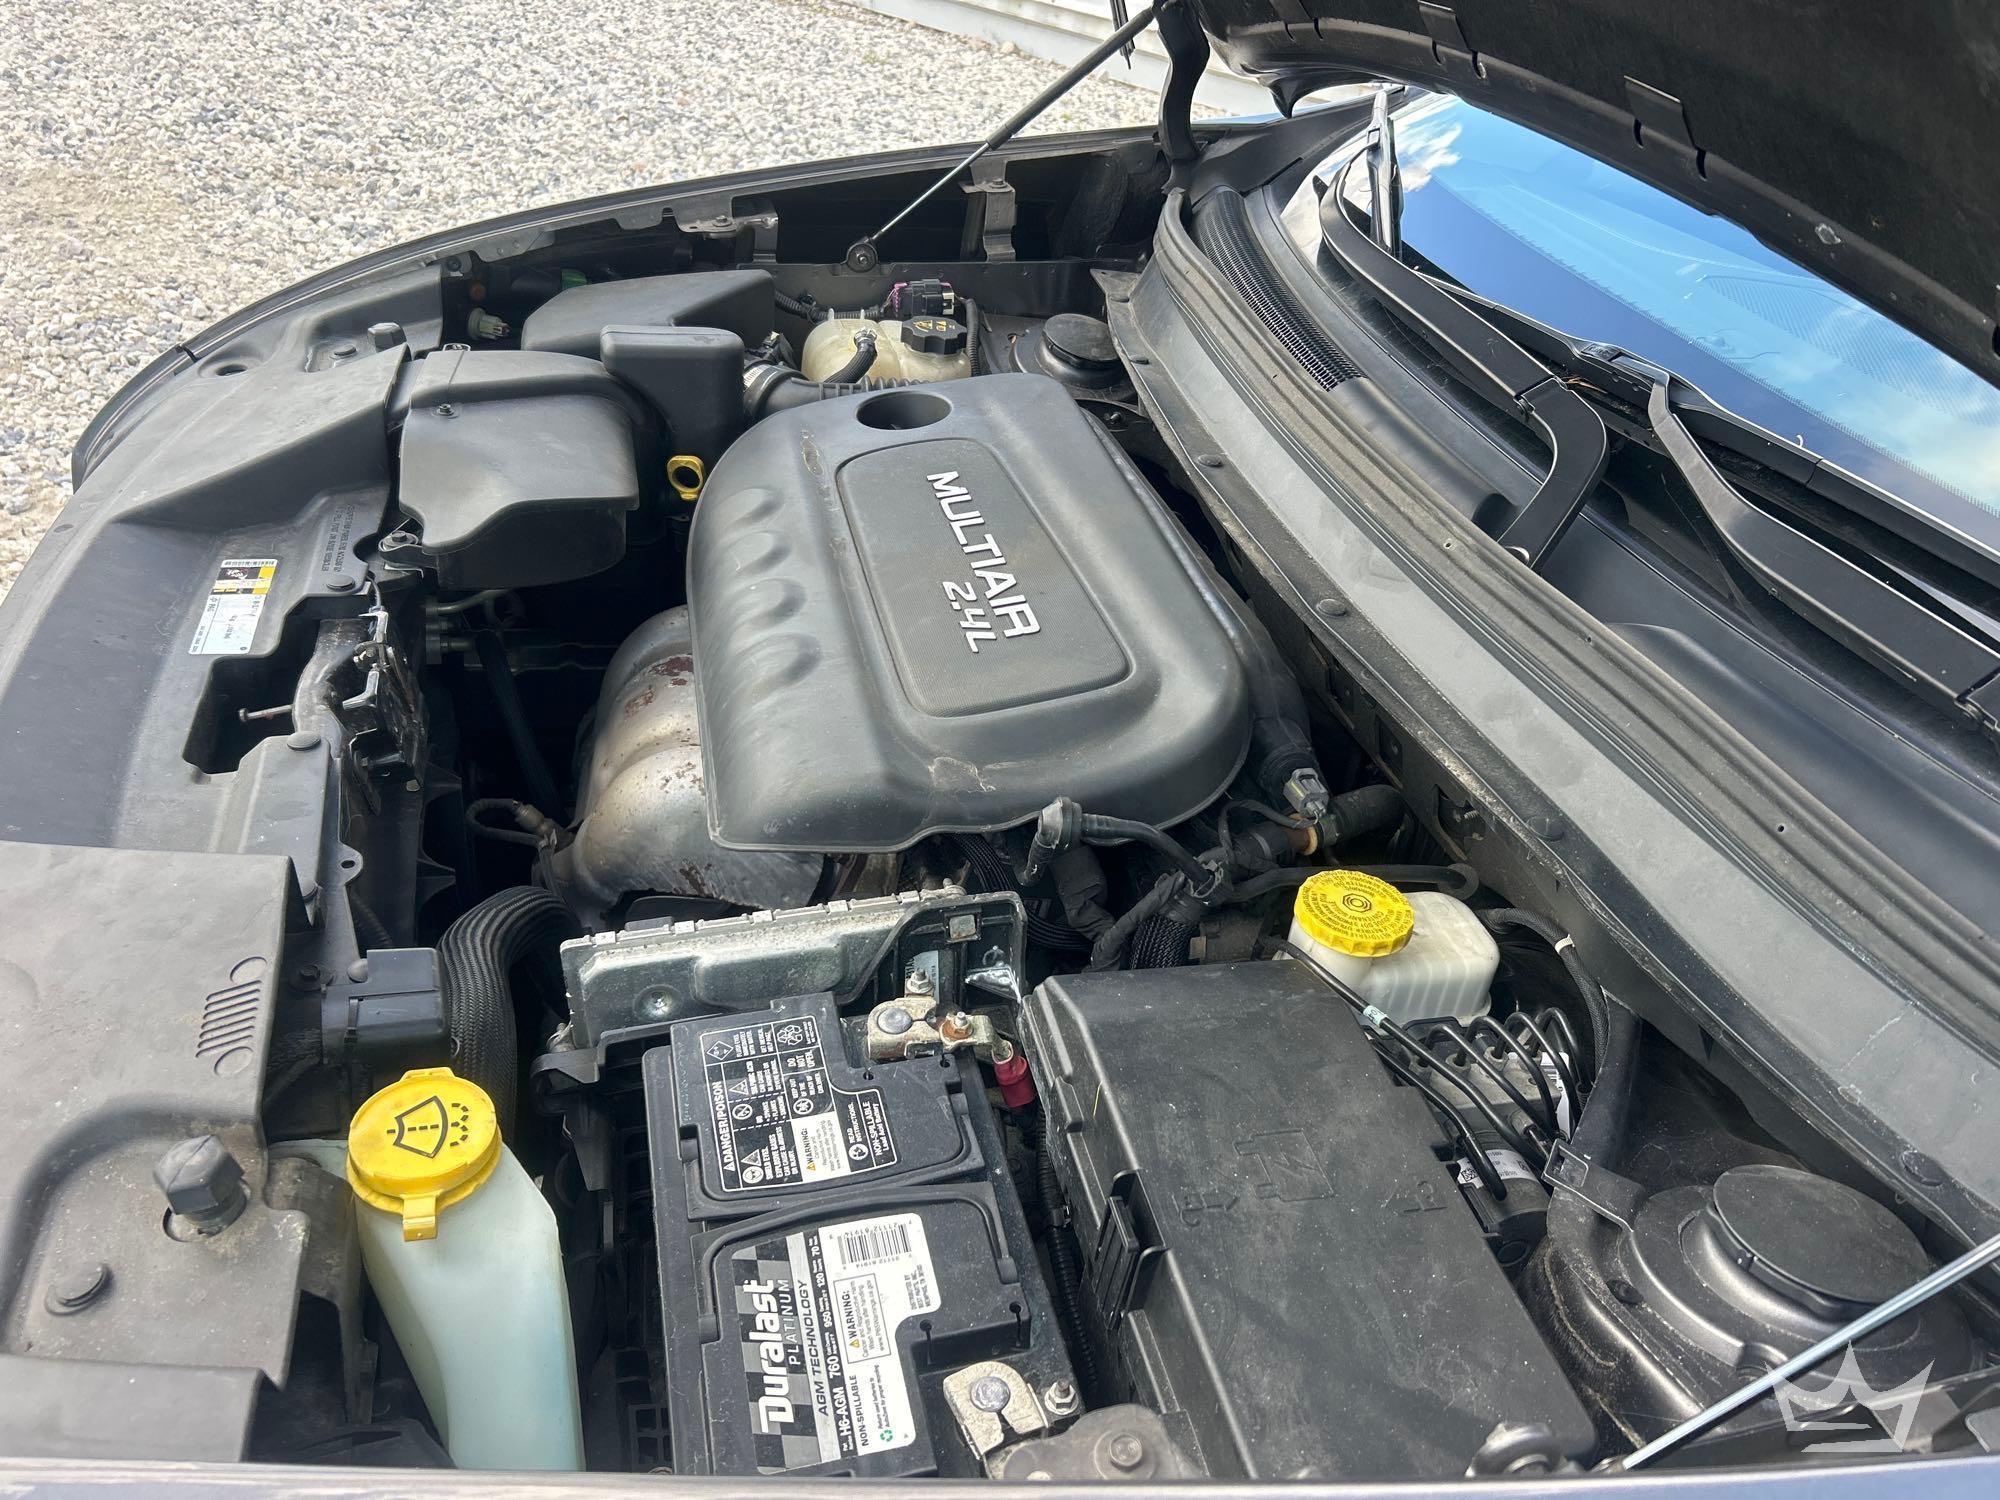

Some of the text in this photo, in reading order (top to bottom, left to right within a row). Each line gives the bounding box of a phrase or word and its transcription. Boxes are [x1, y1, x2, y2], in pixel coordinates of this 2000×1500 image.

[926, 470, 1041, 637] MULTIAIR
[942, 581, 997, 653] 2.4L
[787, 1057, 796, 1067] DO
[796, 1054, 805, 1067] NOT
[711, 1081, 733, 1162] DANGER/POISON
[800, 1127, 813, 1163] WARNING:
[847, 1127, 855, 1143] READ
[862, 1101, 882, 1155] NON-SPILLABLE
[872, 1103, 889, 1150] Lead Acid Battery
[811, 1245, 820, 1256] 70
[815, 1272, 825, 1287] 120
[778, 1279, 801, 1366] PLATINUM
[822, 1310, 832, 1327] 950
[841, 1289, 857, 1338] WARNING:
[743, 1279, 794, 1433] Duralast
[798, 1279, 828, 1416] AGM TECHNOLOGY
[826, 1354, 841, 1378] 760
[832, 1386, 851, 1436] H6-AGM
[849, 1374, 869, 1446] NON-SPILLABLE
